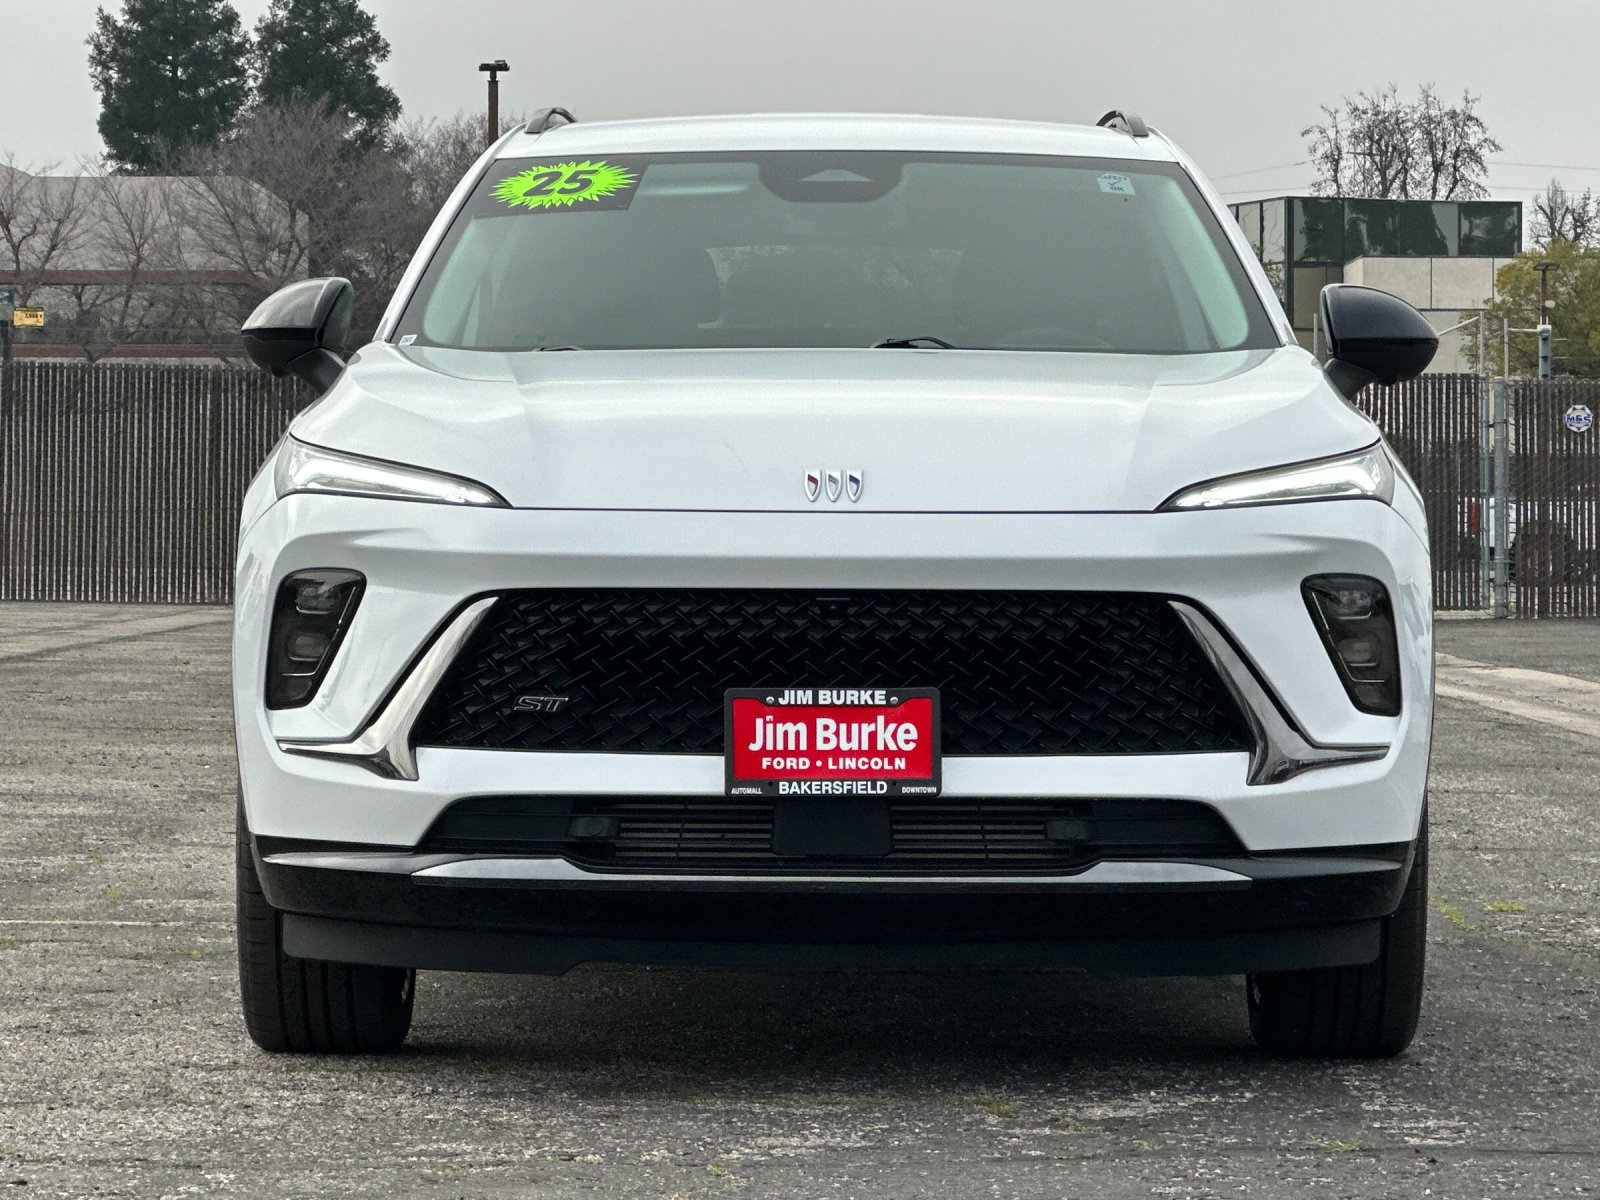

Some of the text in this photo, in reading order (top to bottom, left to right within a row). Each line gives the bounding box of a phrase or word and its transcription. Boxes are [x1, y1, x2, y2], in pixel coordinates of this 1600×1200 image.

[522, 169, 599, 197] 25
[1566, 415, 1592, 423] M&S
[513, 696, 569, 711] ST
[778, 690, 886, 705] JIM BURKE
[748, 715, 918, 751] Jim Burke
[762, 757, 906, 770] FORD LINCOLN
[731, 787, 762, 795] AUTOMALL
[779, 781, 888, 795] BAKERSFIELD
[901, 786, 937, 794] DOWNTOWN
